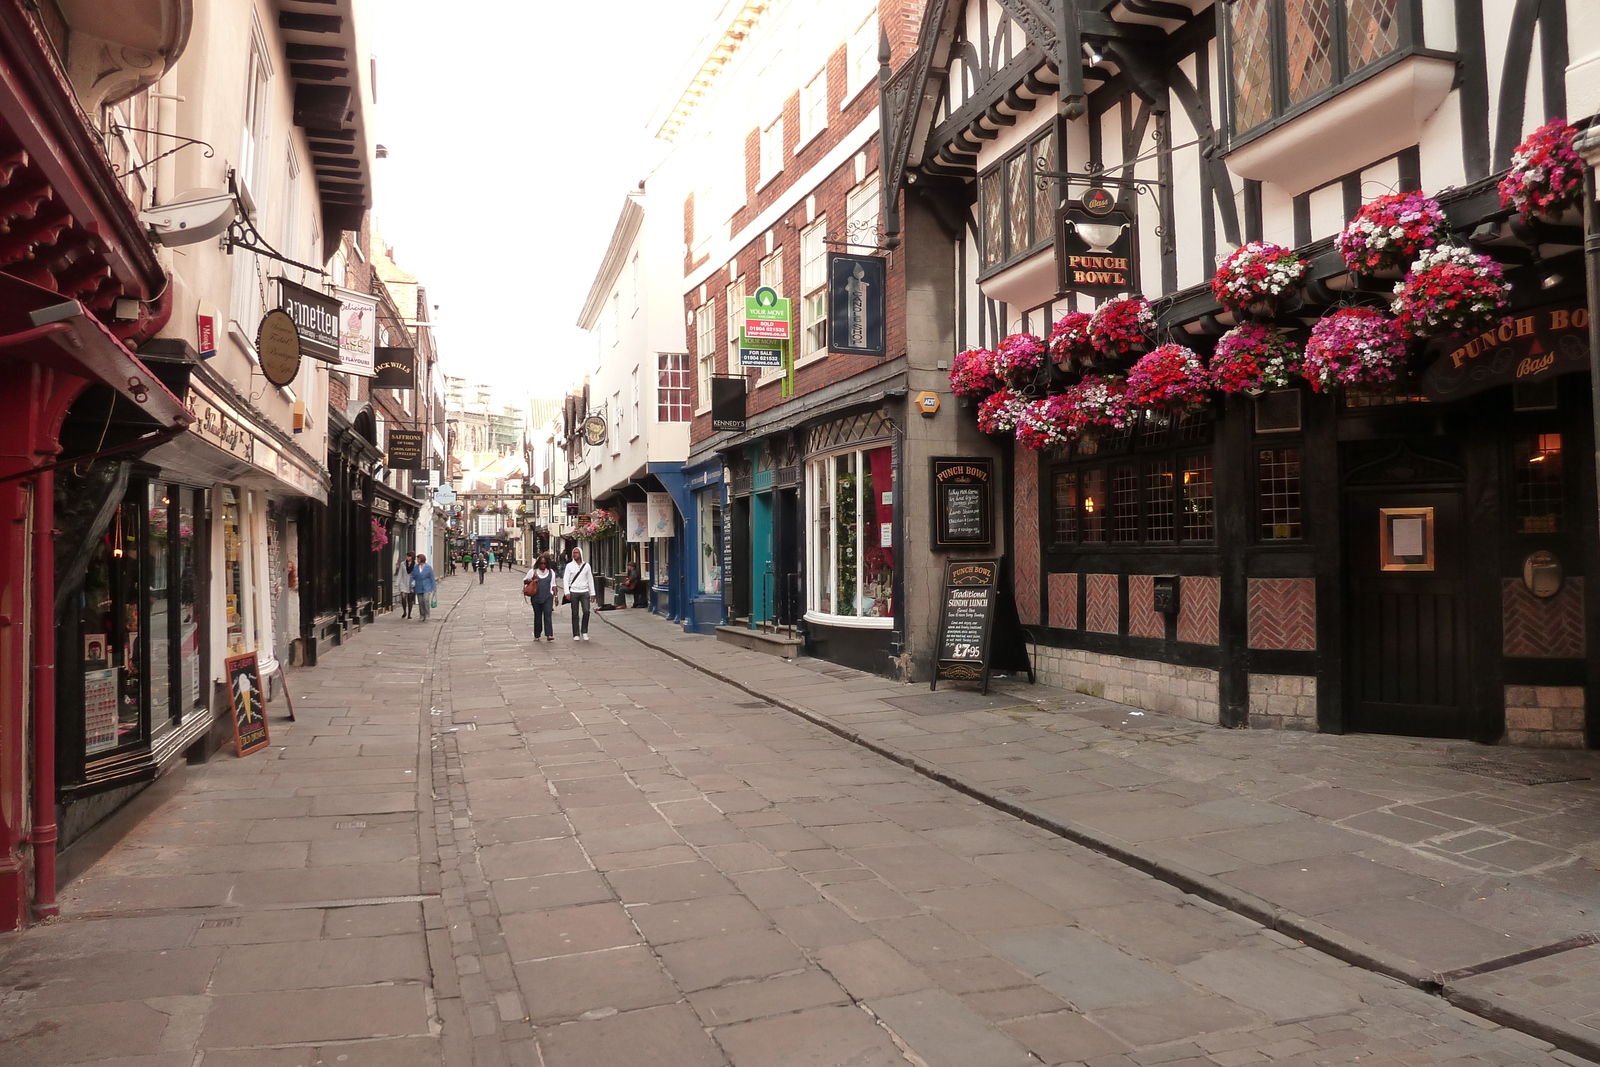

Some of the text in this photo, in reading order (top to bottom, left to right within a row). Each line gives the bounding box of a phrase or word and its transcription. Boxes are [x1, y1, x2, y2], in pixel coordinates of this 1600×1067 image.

[1089, 199, 1108, 209] Bass
[1069, 255, 1128, 270] PUNCH
[1074, 270, 1126, 285] BOWL
[341, 303, 373, 311] Delicious
[852, 291, 863, 323] CANDLE
[852, 324, 863, 345] SHOP
[346, 338, 363, 348] ICE
[1450, 315, 1535, 369] PUNCH
[346, 356, 370, 366] FLAVOURS
[1516, 351, 1555, 378] Bass
[375, 362, 411, 374] JACK WILLS
[937, 466, 988, 482] PUNCH BOWL
[952, 566, 991, 578] PUNCH BOWL
[951, 589, 987, 599] Traditional
[948, 599, 988, 607] SUNDAY LUNCH
[240, 730, 265, 747] COLD DRINKS
